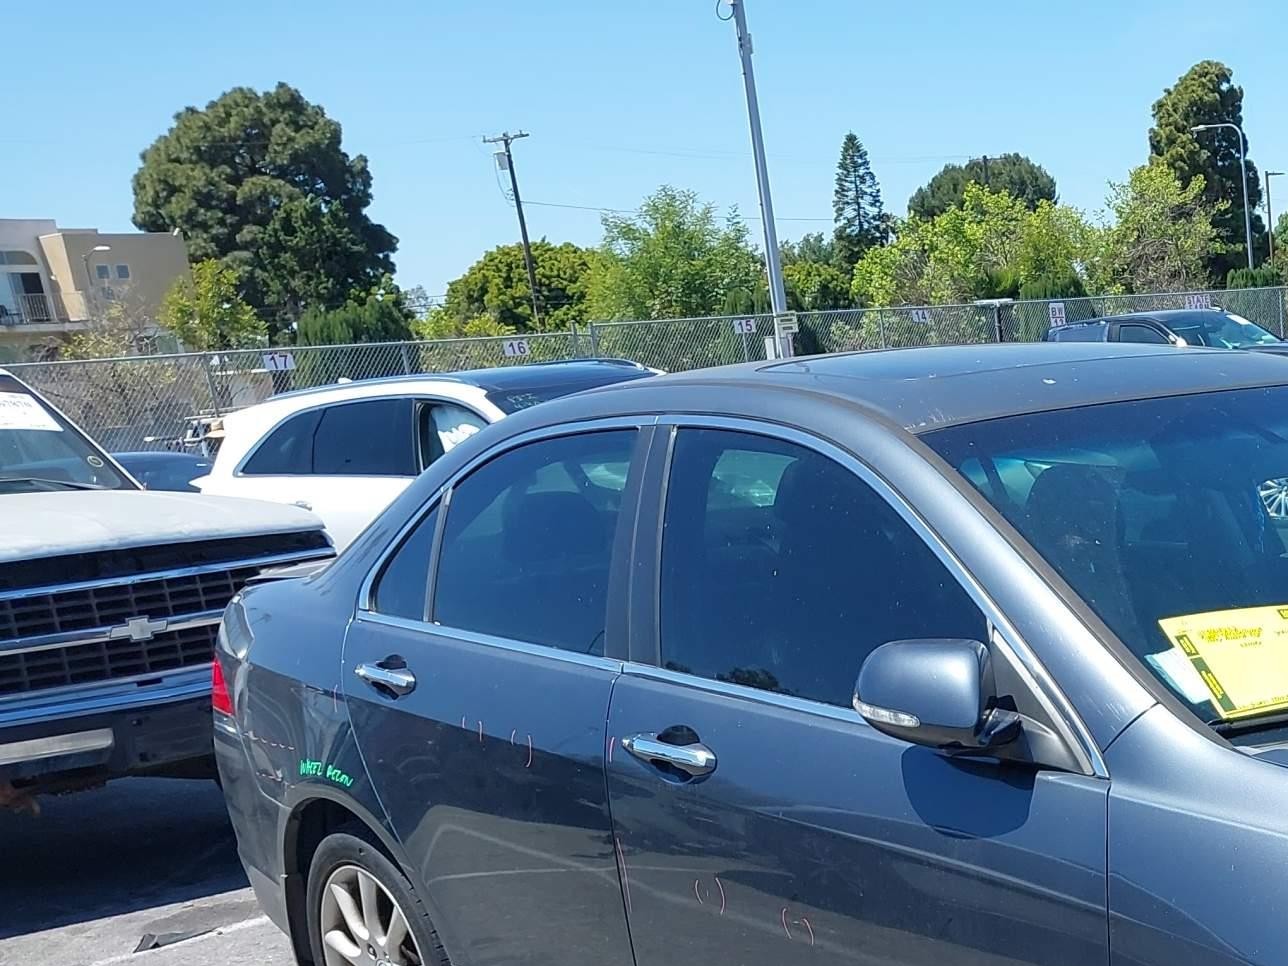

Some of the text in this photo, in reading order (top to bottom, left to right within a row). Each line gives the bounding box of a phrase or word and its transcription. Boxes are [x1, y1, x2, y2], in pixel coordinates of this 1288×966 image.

[916, 310, 926, 321] 14
[738, 320, 752, 332] 15
[509, 341, 527, 354] 16
[270, 354, 288, 369] 17
